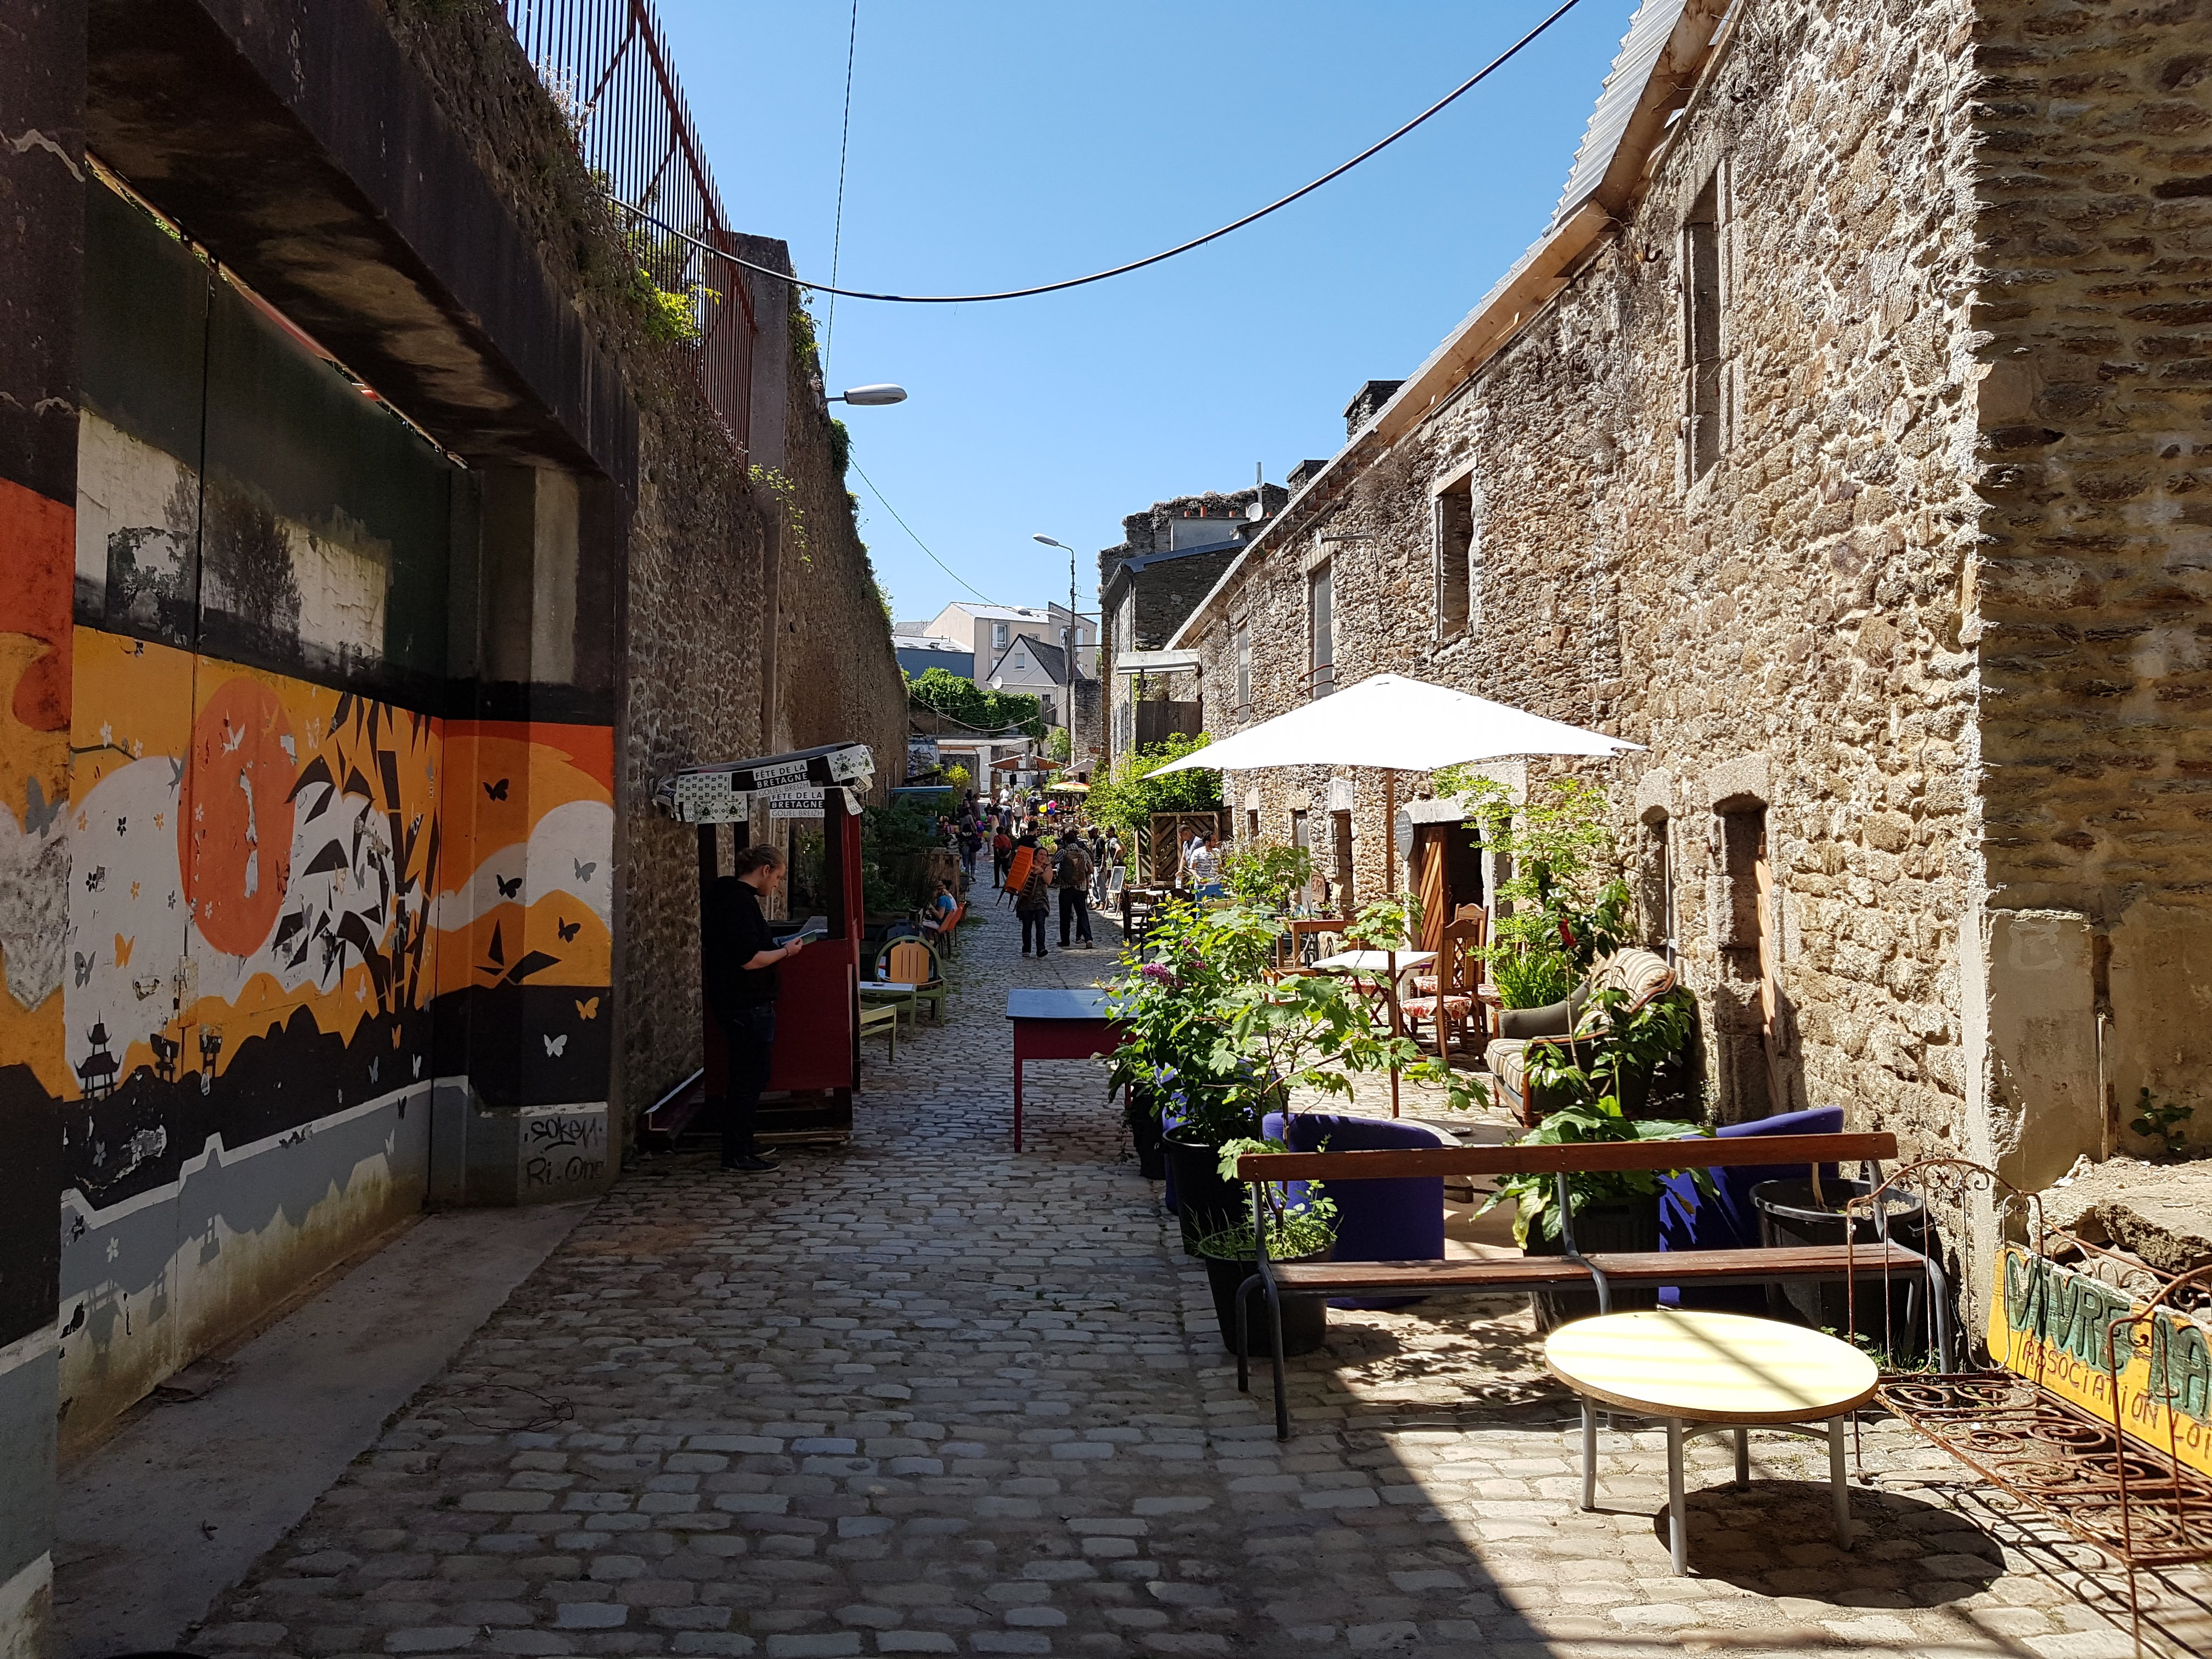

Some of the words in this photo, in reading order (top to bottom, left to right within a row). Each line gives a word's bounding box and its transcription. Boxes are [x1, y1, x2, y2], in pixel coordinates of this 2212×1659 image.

[755, 769, 776, 779] FÊTE
[779, 766, 791, 775] DE
[794, 764, 805, 772] LA
[757, 772, 808, 788] BRETAGNE
[759, 787, 782, 796] GOUEL
[785, 781, 809, 792] BREIZH
